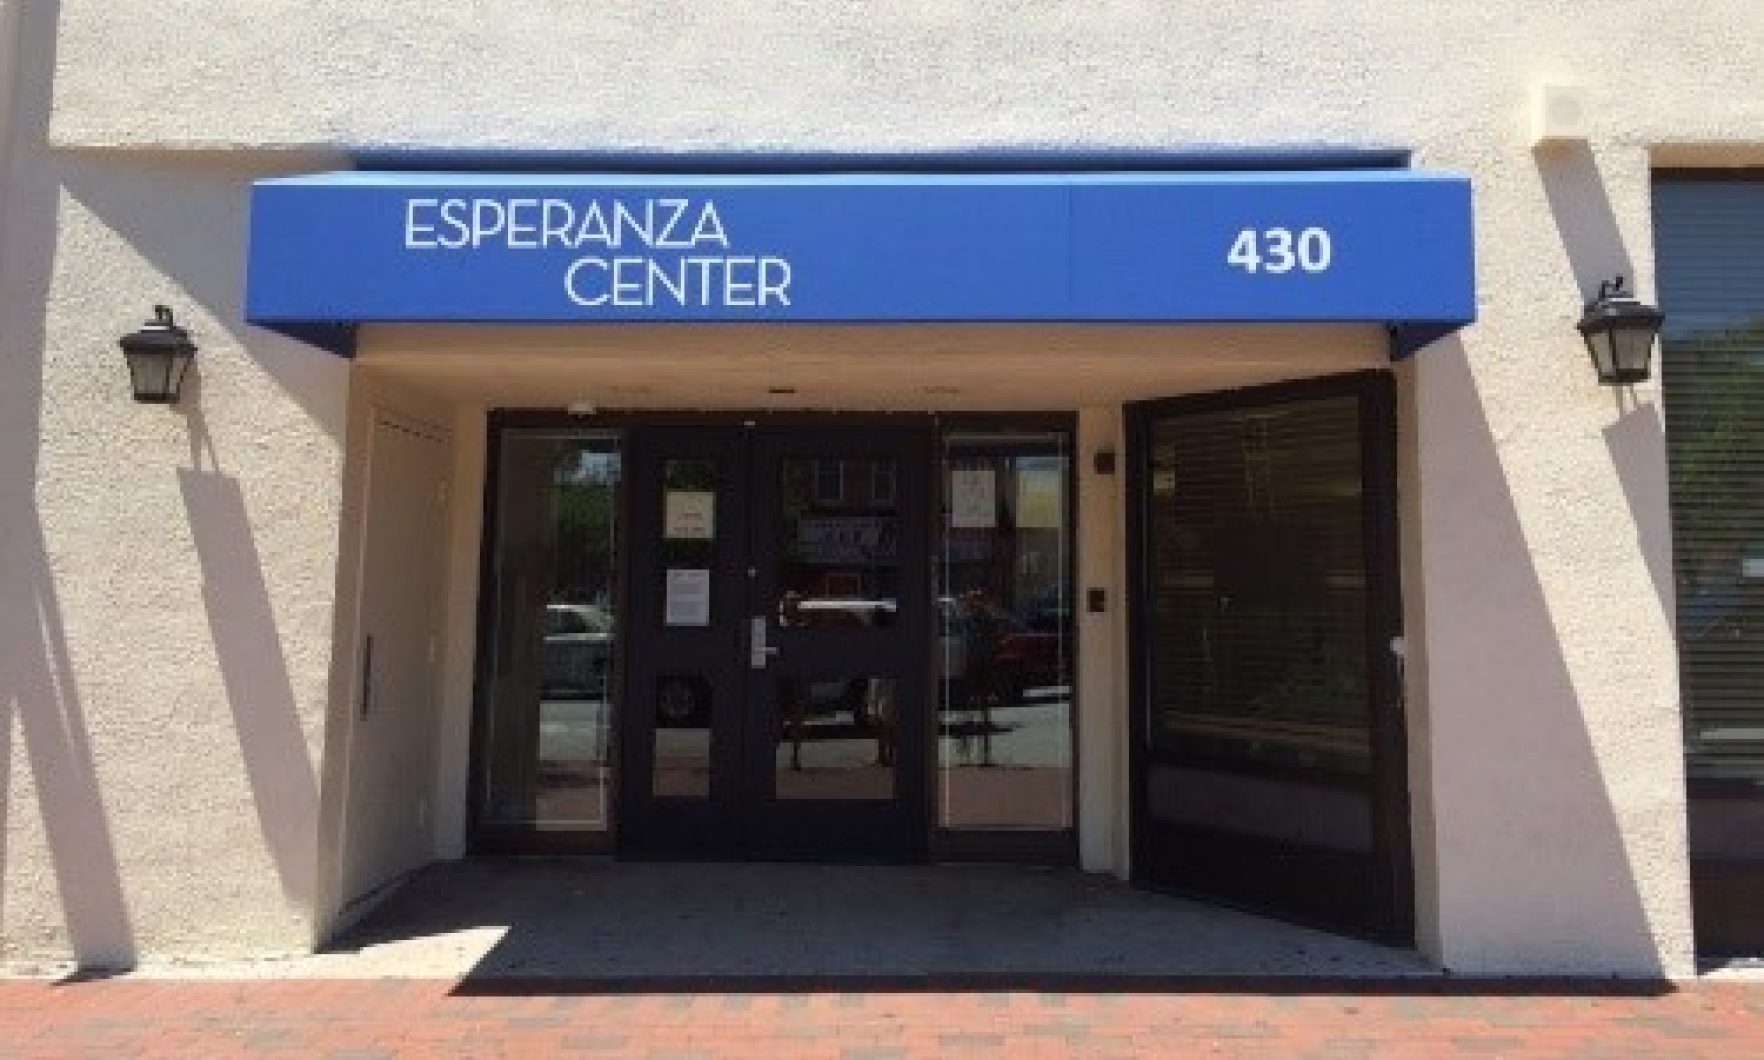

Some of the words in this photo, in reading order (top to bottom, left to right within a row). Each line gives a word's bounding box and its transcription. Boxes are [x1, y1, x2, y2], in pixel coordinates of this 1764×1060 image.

[405, 198, 730, 249] ESPERANZA
[1227, 226, 1331, 274] 430
[564, 256, 792, 306] CENTER
